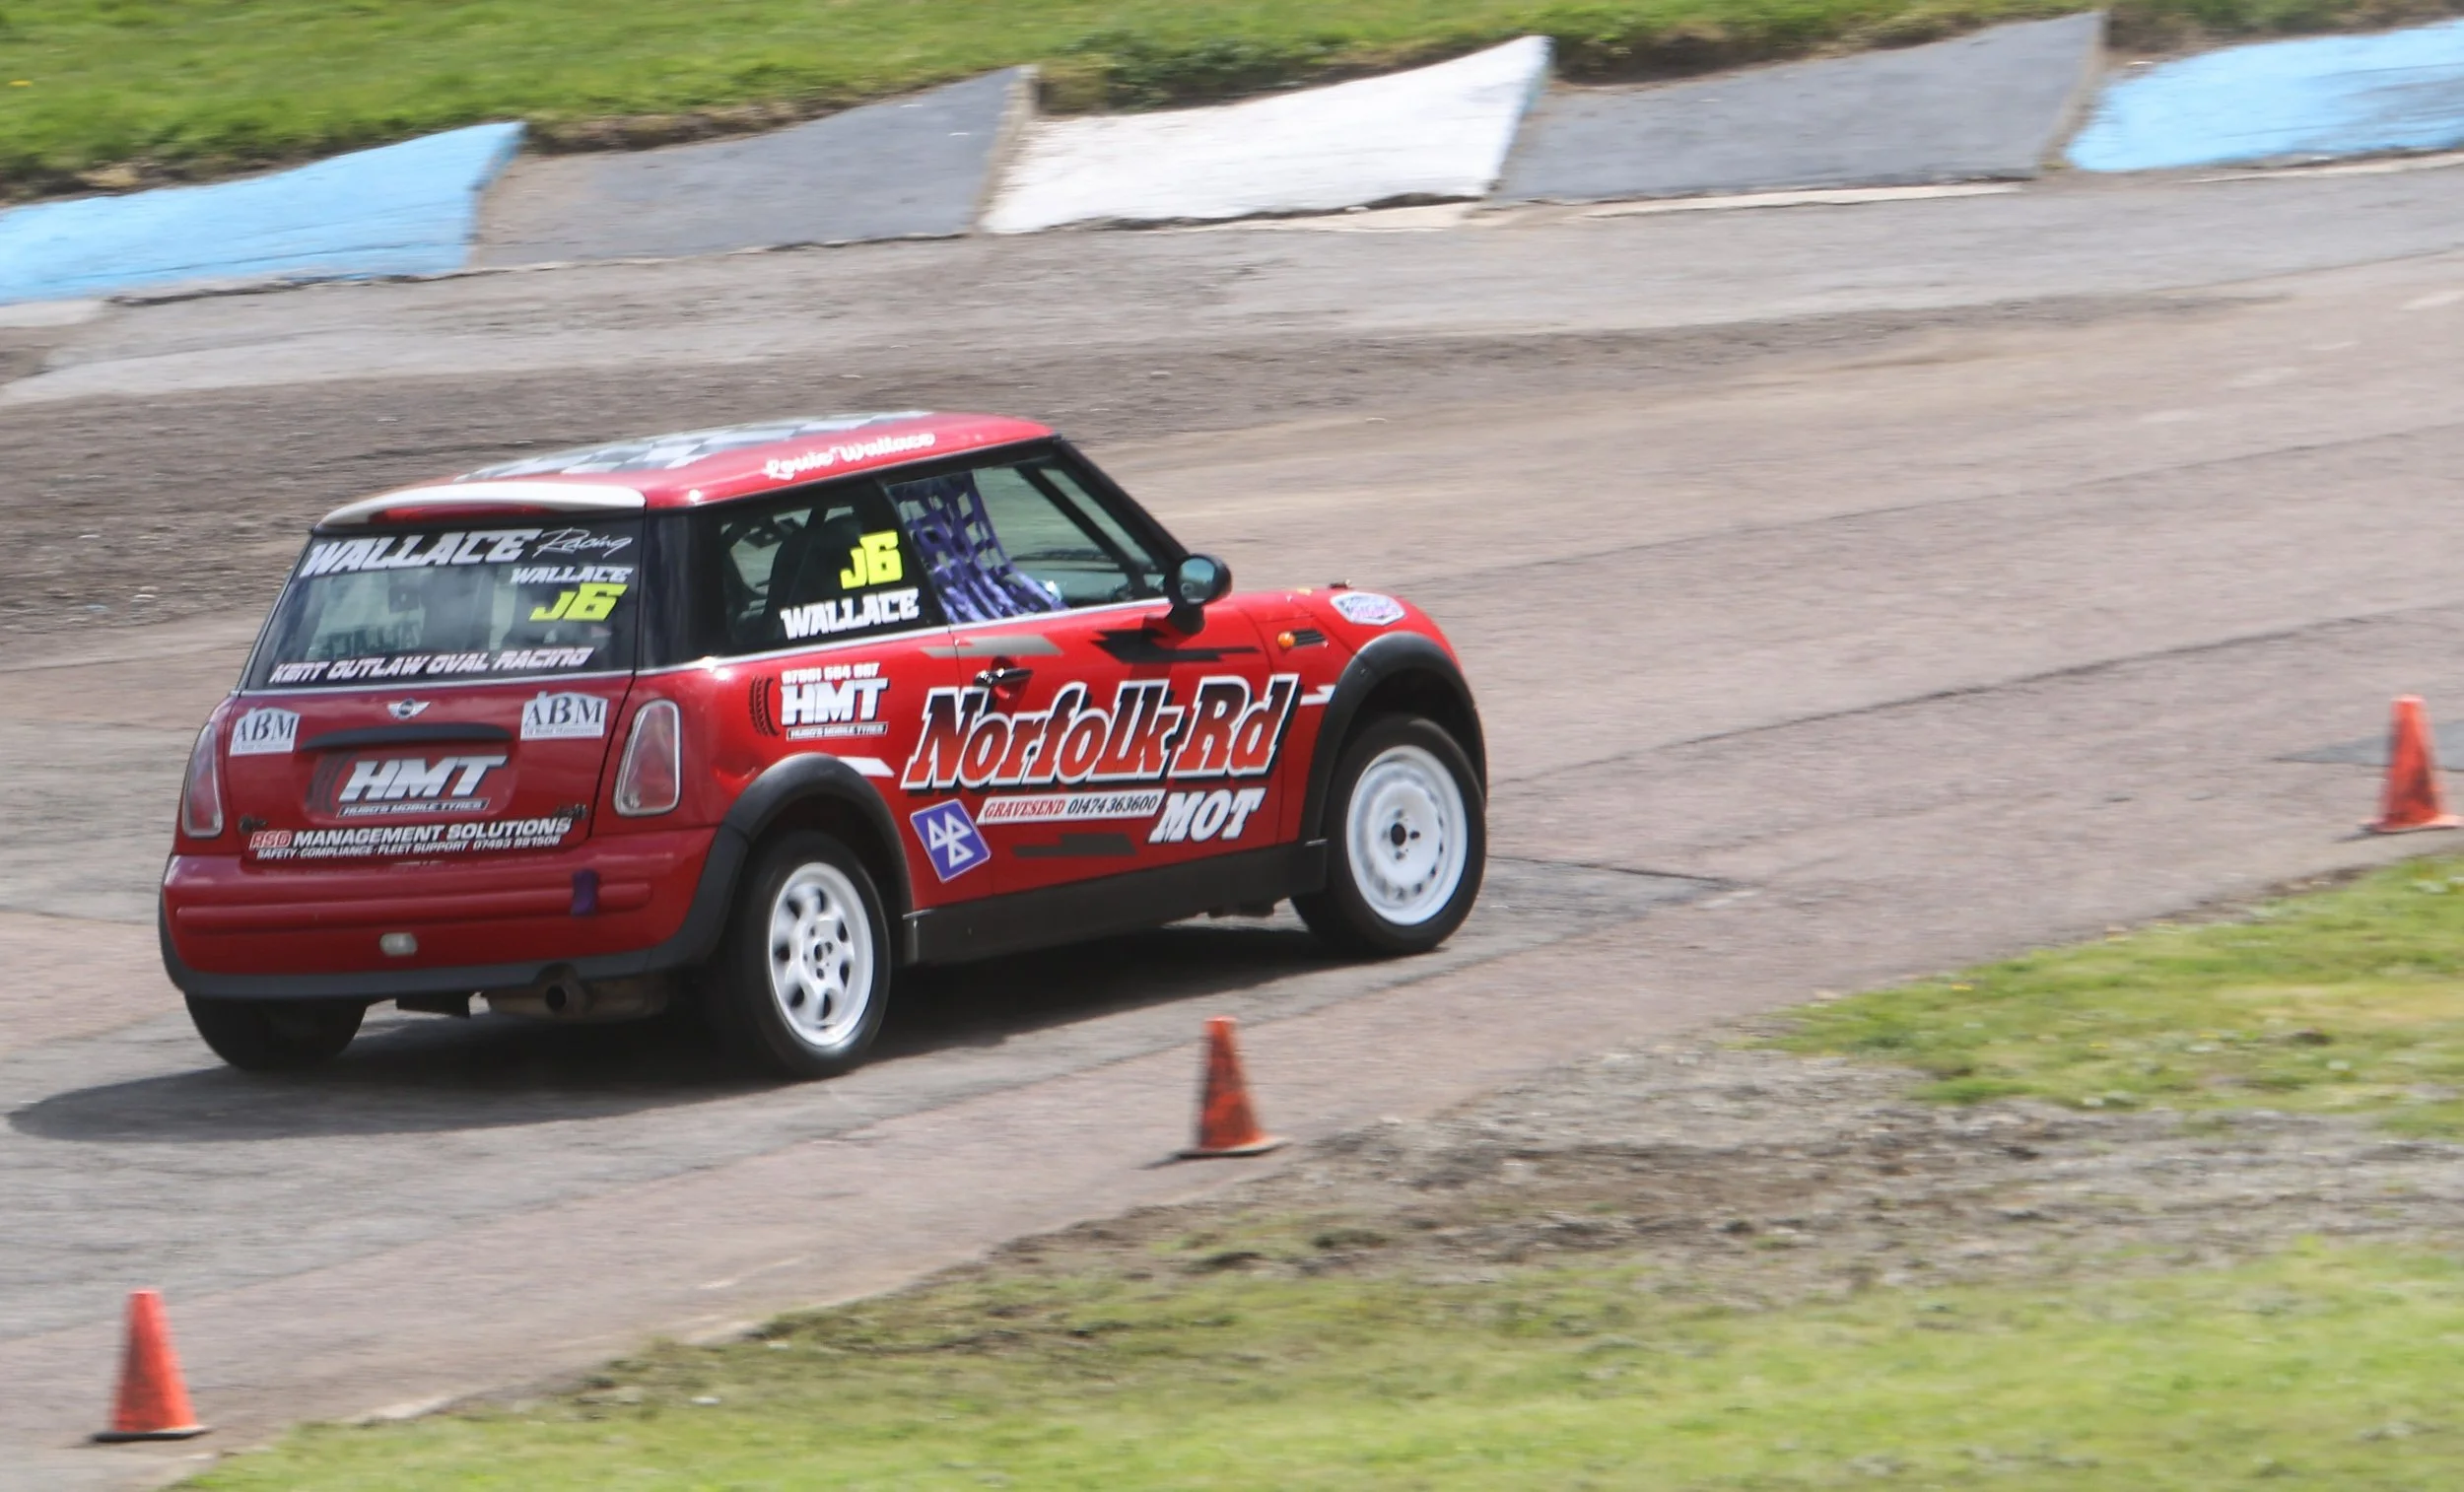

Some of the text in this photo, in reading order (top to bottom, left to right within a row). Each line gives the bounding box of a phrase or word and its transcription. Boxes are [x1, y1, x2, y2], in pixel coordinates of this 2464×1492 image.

[299, 527, 634, 578] WALLACE Racing
[841, 530, 903, 588] J6
[511, 566, 634, 584] WALLACE
[528, 582, 628, 622] J6
[780, 587, 920, 640] WALLACE
[268, 646, 594, 684] KENT OUTLAW OVAL RACING
[525, 696, 603, 726] ABM
[781, 677, 889, 725] HMT
[235, 712, 296, 742] ABM
[900, 674, 1301, 789] Norfolk Rd
[338, 755, 508, 802] HMT
[389, 801, 436, 814] MOBILE
[440, 800, 483, 811] TYRES
[986, 799, 1066, 818] GRAVESEND
[1148, 787, 1266, 844] MOT
[257, 847, 297, 860] SAFETY
[300, 845, 374, 859] COMPLIANCE
[377, 843, 412, 856] FLEET
[412, 840, 469, 854] SUPPORT
[294, 824, 445, 848] MANAGEMENT
[446, 816, 573, 841] SOLUTIONS
